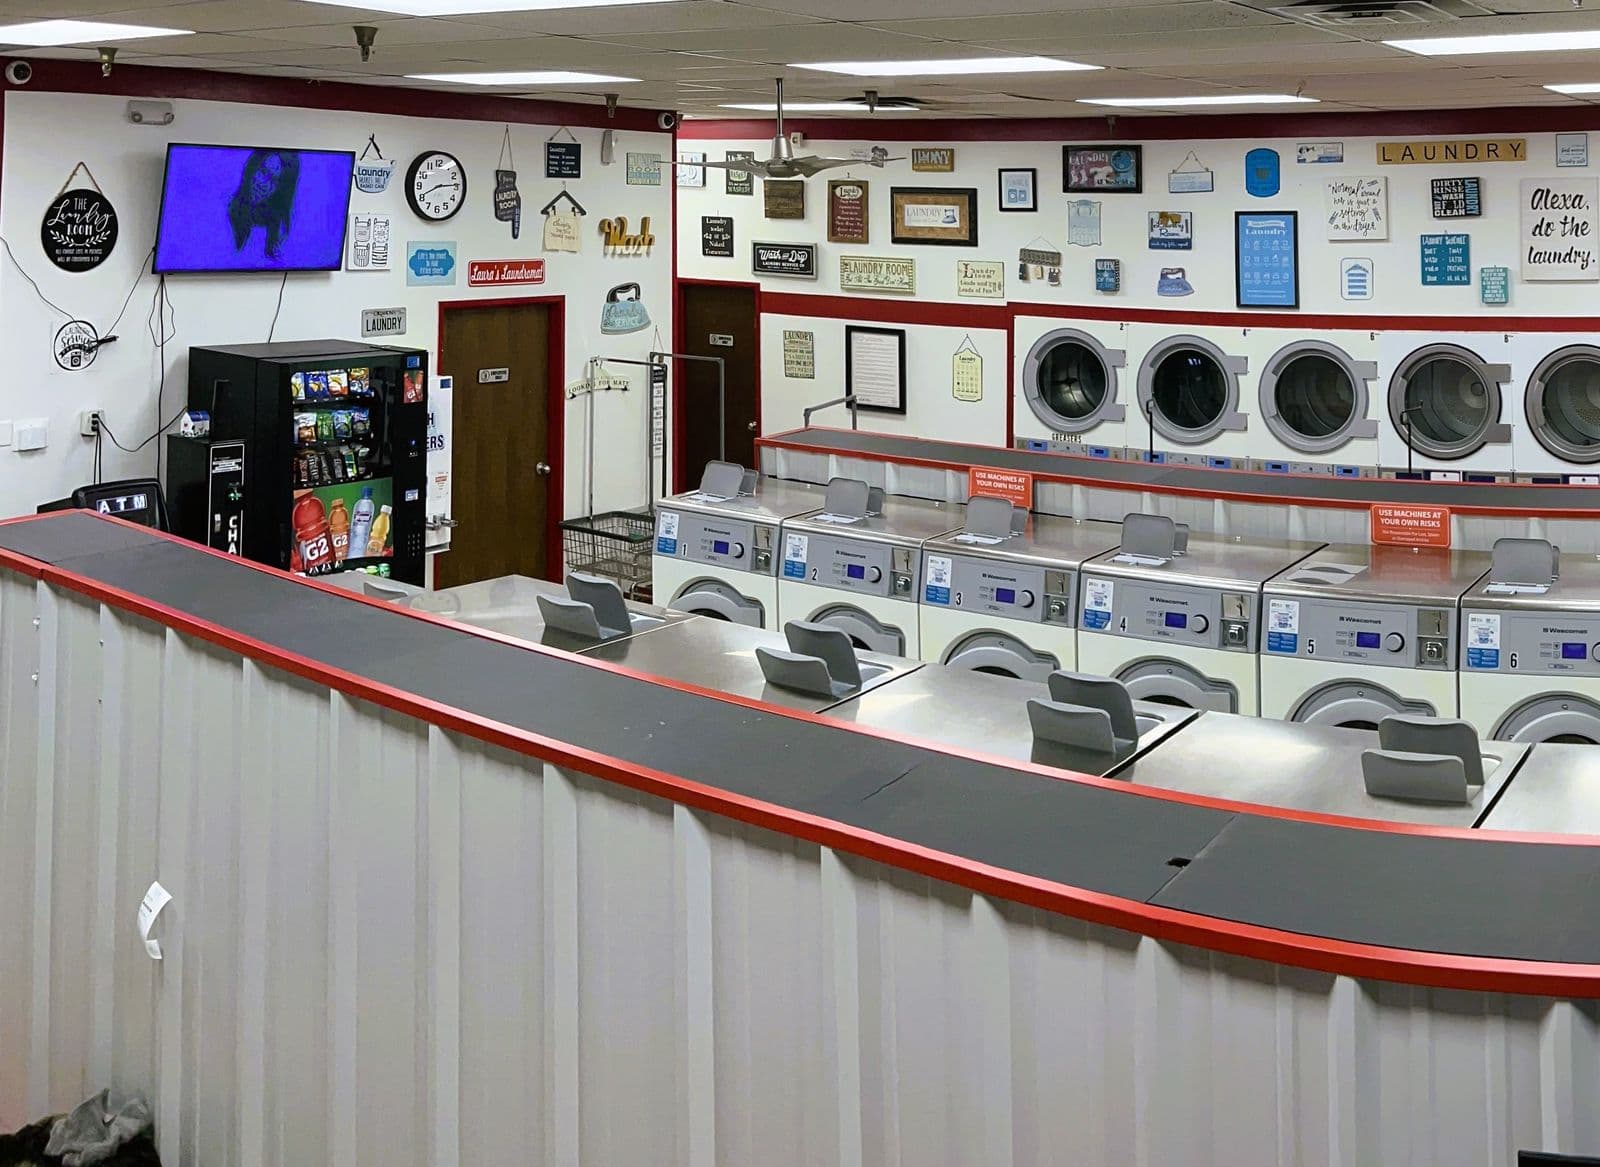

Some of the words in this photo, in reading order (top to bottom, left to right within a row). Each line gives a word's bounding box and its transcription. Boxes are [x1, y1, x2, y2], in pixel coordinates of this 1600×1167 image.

[1382, 142, 1522, 162] LAUNDRY
[358, 168, 390, 179] Laundry
[496, 190, 517, 201] LAUNDRY
[1465, 179, 1479, 215] LAUNDRY
[1531, 188, 1590, 211] Alexa,
[74, 198, 87, 210] THE
[499, 200, 517, 209] ROOM
[906, 207, 942, 218] LAUNDRY
[67, 224, 93, 236] ROOM
[1246, 228, 1288, 236] Laundry
[1532, 217, 1556, 237] do
[1560, 215, 1591, 237] the
[598, 216, 656, 258] Wash
[759, 249, 782, 260] Wash
[788, 250, 808, 264] Dry
[1528, 246, 1596, 270] laundry.
[471, 265, 500, 281] Laura's
[501, 263, 543, 280] Laundromat
[849, 262, 883, 274] LAUNDRY
[886, 263, 910, 276] ROOM
[366, 317, 402, 332] LAUNDRY
[1243, 329, 1247, 337] 4
[1370, 332, 1375, 341] 6
[1504, 334, 1509, 343] 8
[987, 473, 1017, 482] MACHINES
[976, 480, 992, 488] YOUR
[993, 481, 1008, 489] OWN
[99, 495, 146, 514] ATM
[1394, 510, 1431, 518] MACHINES
[1420, 520, 1440, 528] RISKS
[333, 535, 348, 548] G2
[306, 538, 329, 560] G2
[683, 544, 687, 556] 1
[812, 569, 818, 581] 2
[955, 592, 962, 605] 3
[1120, 619, 1126, 632] 4
[1307, 640, 1314, 653] 5
[1510, 653, 1517, 668] 6
